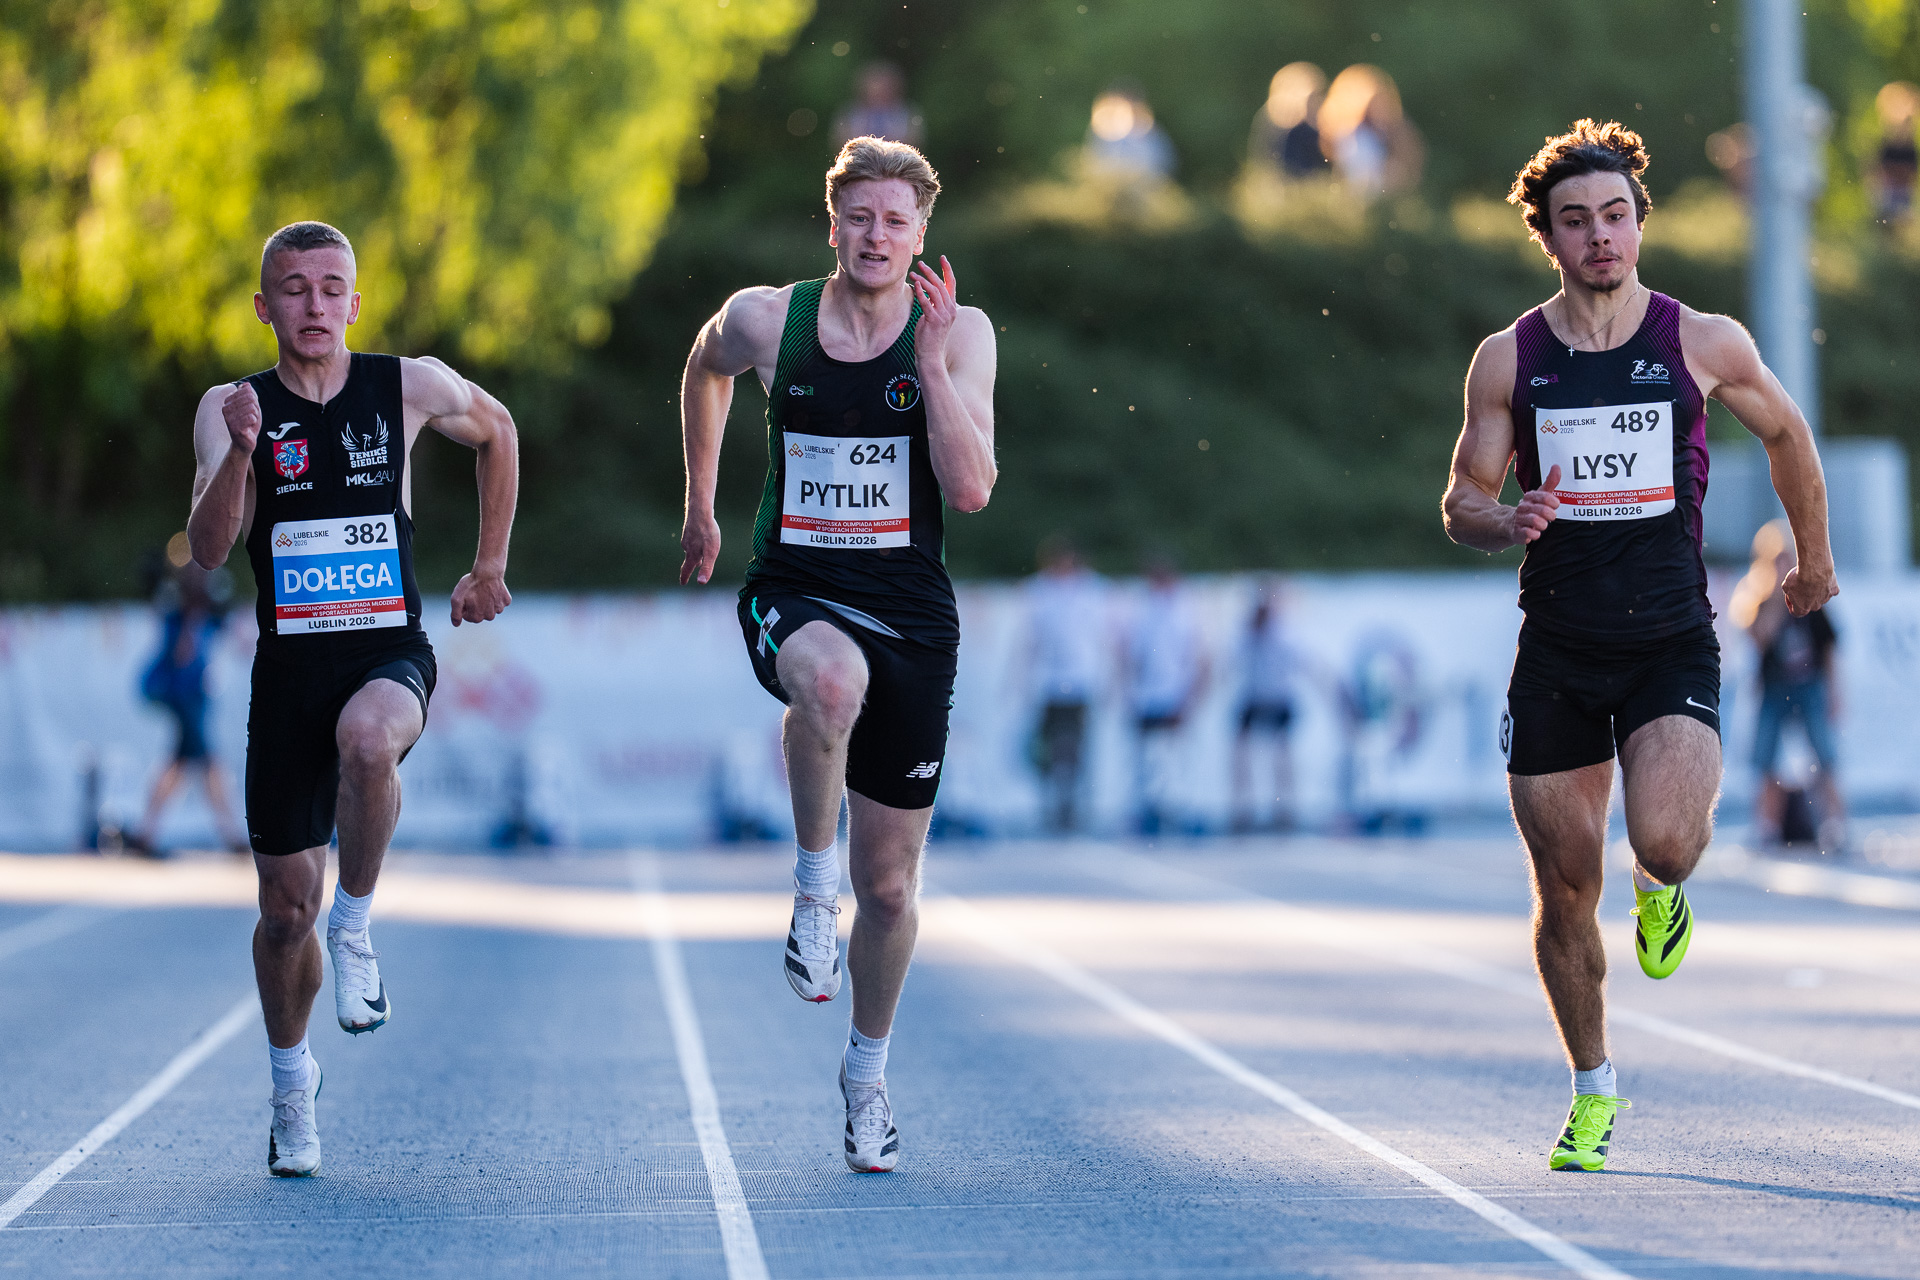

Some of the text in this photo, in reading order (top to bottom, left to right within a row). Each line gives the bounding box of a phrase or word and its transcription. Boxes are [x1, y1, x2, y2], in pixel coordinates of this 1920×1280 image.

[1530, 373, 1559, 386] esa
[788, 384, 814, 396] esa
[1560, 410, 1660, 433] LUBELSKIE 489
[348, 446, 388, 460] FENIKS
[804, 444, 896, 465] LUBELSKIE 624
[350, 455, 388, 469] SIEDLCE
[1573, 452, 1638, 480] LYSY
[276, 482, 313, 495] SIEDLCE
[801, 480, 890, 508] PYTLIK
[1638, 488, 1666, 496] MŁODZIEŻY
[1573, 506, 1642, 516] LUBLIN 2026
[802, 518, 842, 527] OGÓLNOPOLSKA
[293, 522, 388, 546] LUBELSKIE 382
[810, 534, 876, 544] LUBLIN 2026
[284, 562, 394, 594] DOŁĘGA
[297, 604, 340, 612] OGÓLNOPOLSKA
[308, 616, 376, 630] LUBLIN 2026
[1501, 714, 1510, 754] 3
